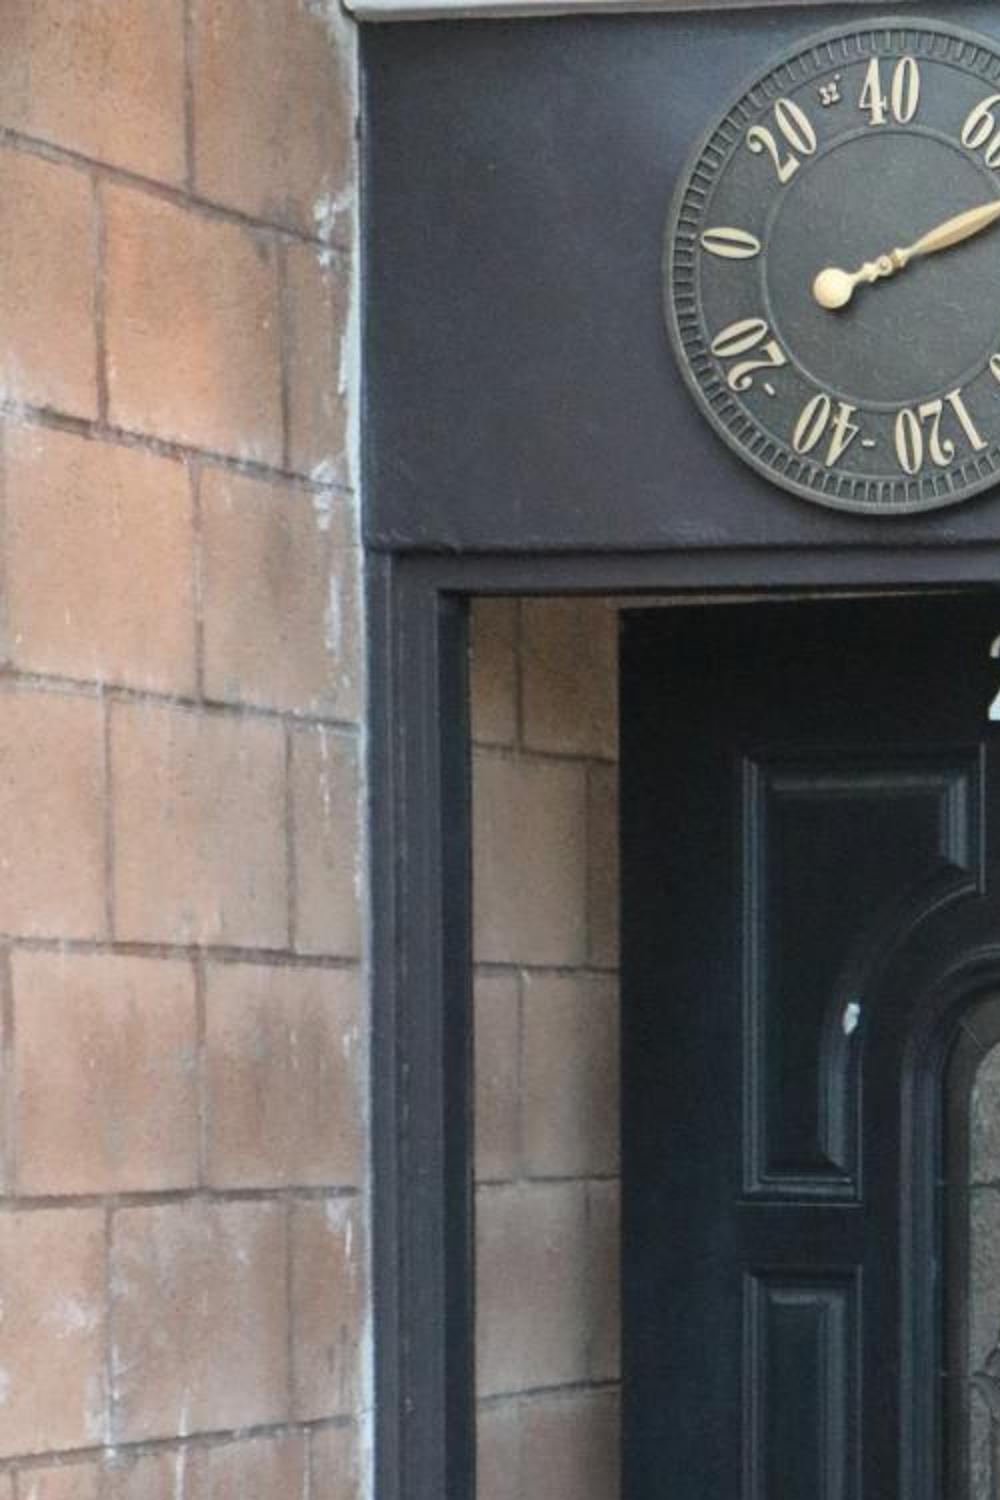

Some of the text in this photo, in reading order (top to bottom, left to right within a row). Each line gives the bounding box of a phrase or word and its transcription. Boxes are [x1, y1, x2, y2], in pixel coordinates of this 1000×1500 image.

[858, 56, 921, 126] 40
[745, 98, 817, 183] 20
[700, 226, 761, 260] 0
[894, 388, 988, 476] 120
